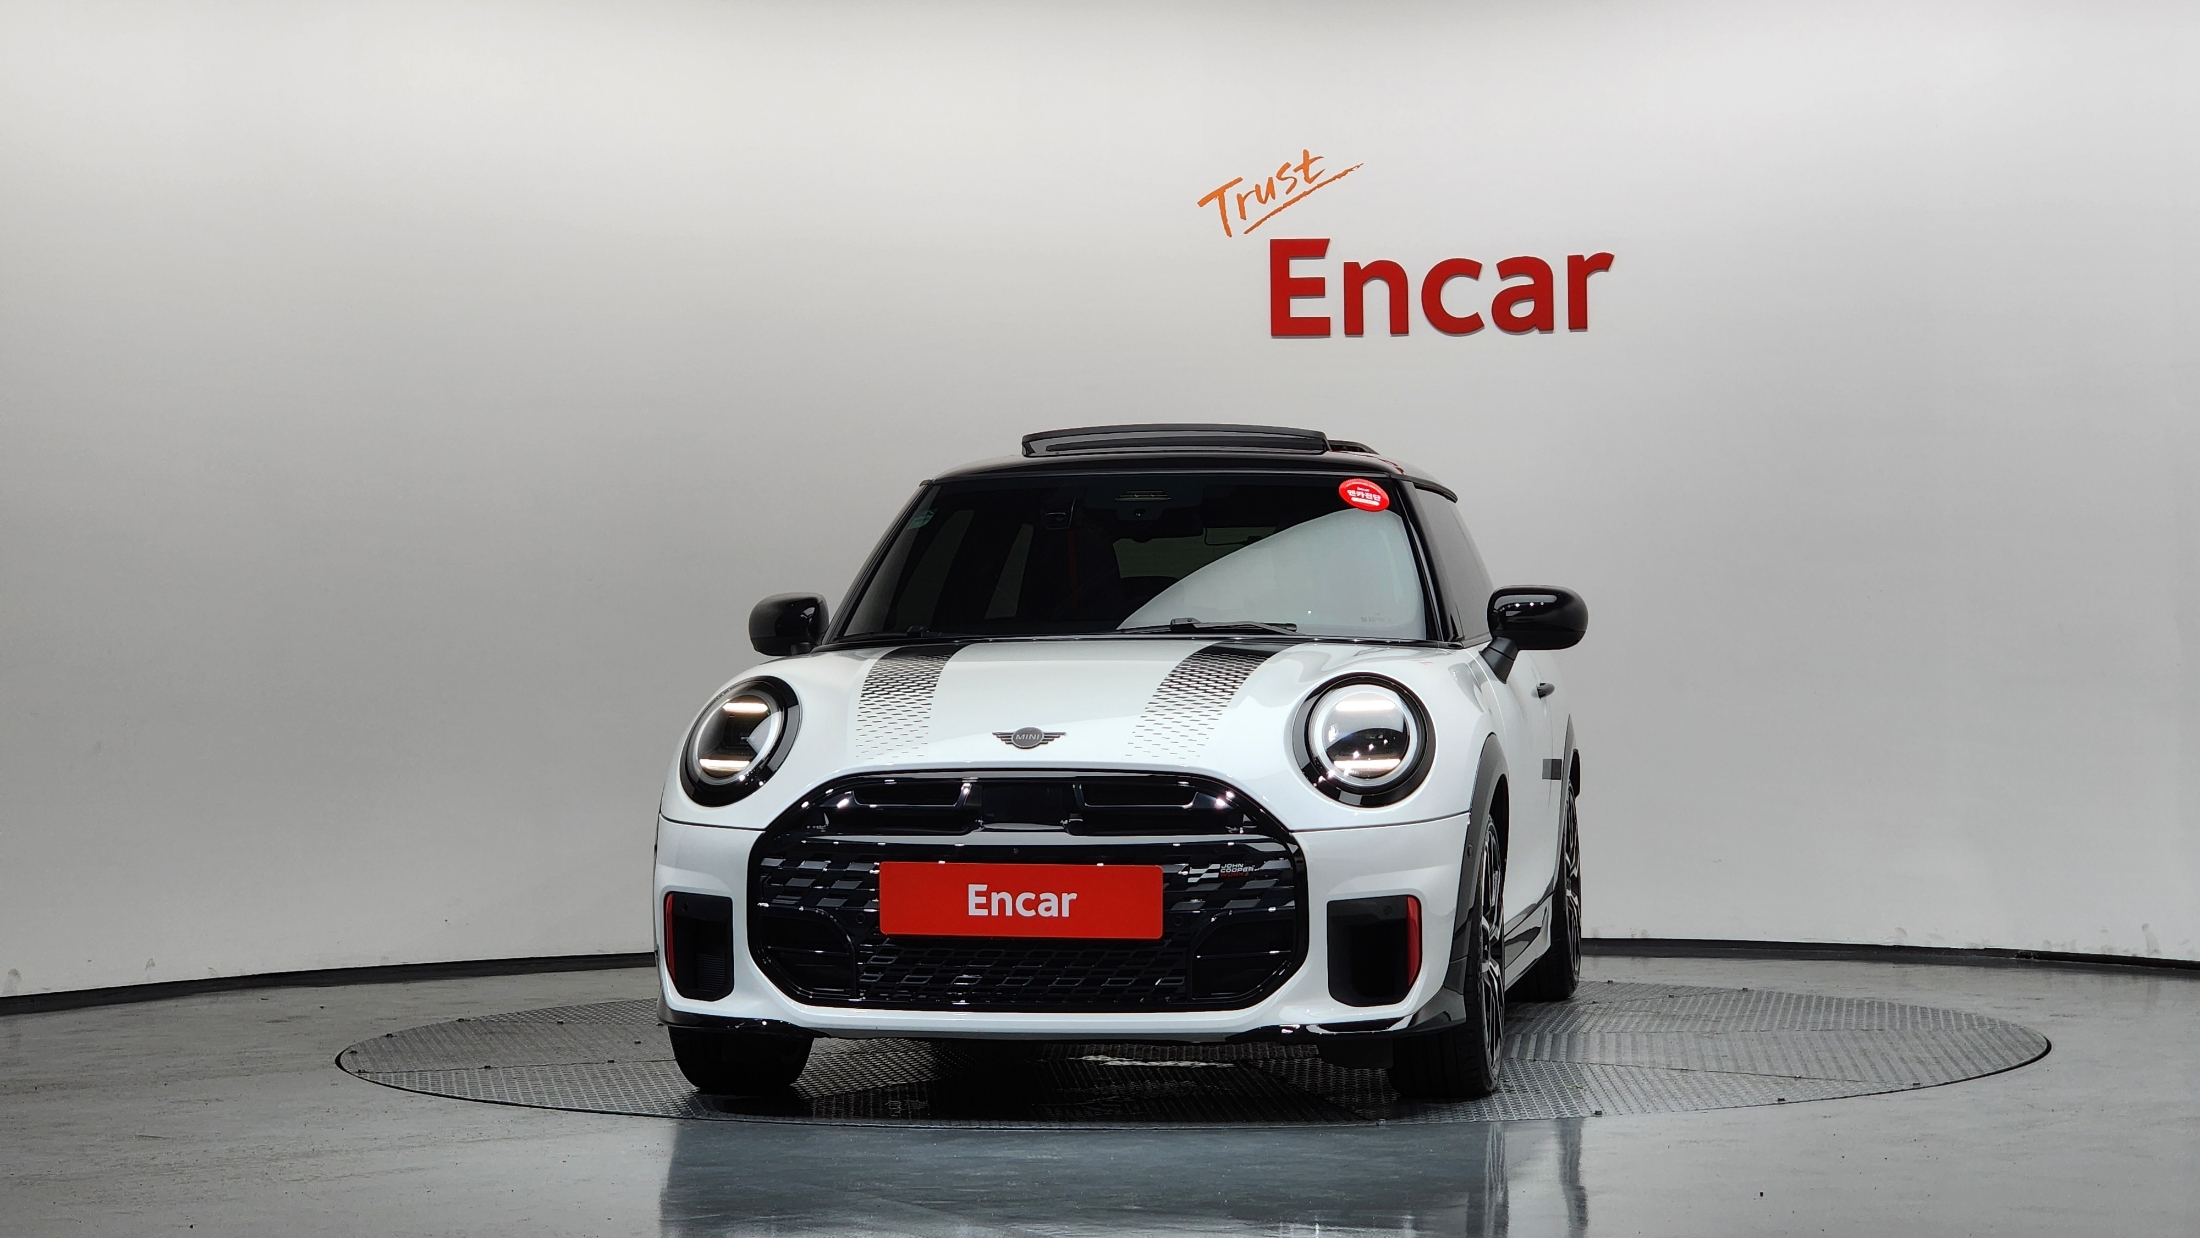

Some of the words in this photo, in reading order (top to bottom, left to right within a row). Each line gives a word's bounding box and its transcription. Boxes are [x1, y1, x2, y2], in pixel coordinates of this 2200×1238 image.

[1197, 149, 1325, 238] Trust
[1269, 237, 1616, 338] Encar
[967, 883, 1078, 918] Encar
